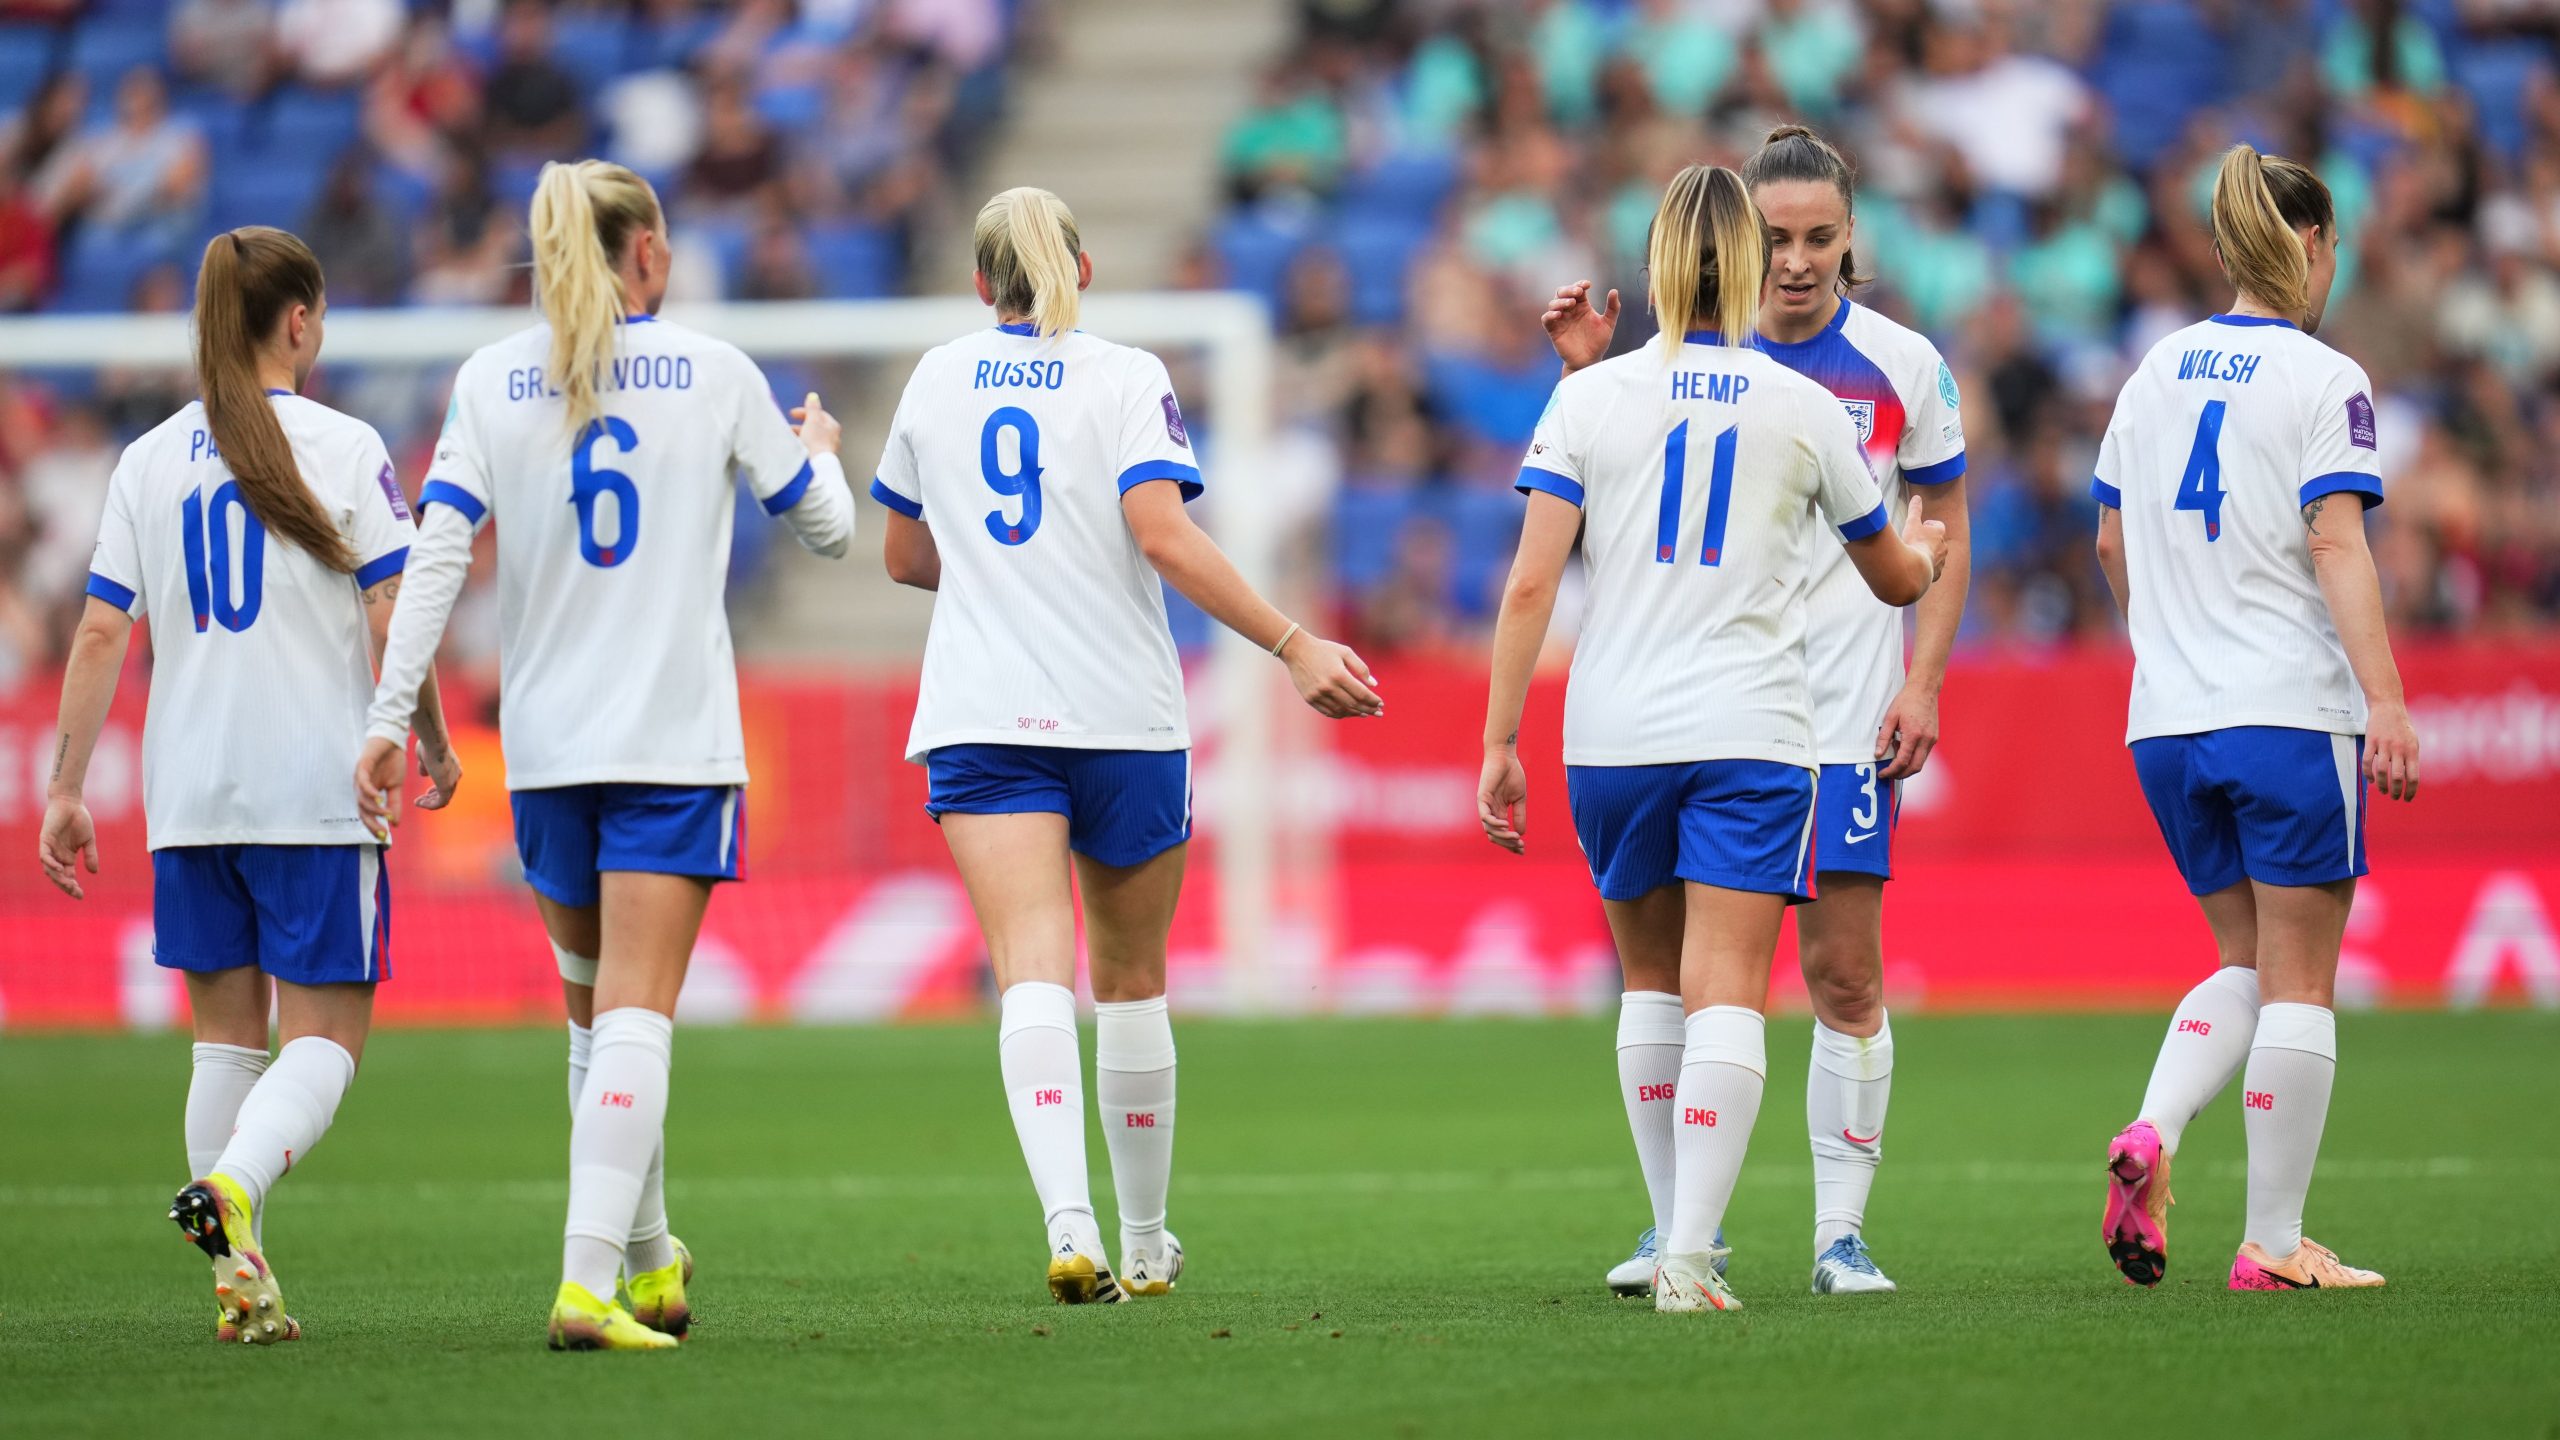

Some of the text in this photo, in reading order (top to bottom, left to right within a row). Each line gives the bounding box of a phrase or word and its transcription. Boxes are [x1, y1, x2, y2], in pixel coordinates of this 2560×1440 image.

[509, 355, 692, 401] GRWOOD
[973, 359, 1064, 390] RUSSO
[2177, 349, 2262, 384] WALSH
[1671, 370, 1750, 405] HEMP
[980, 405, 1046, 546] 9
[2173, 399, 2228, 542] 4
[568, 415, 640, 569] 6
[1655, 417, 1739, 567] 11
[182, 479, 266, 633] 10
[1039, 718, 1059, 730] CAP
[1852, 762, 1878, 830] 3
[2177, 1019, 2212, 1036] ENG
[601, 1091, 634, 1109] ENG
[1035, 1088, 1063, 1107] ENG
[1638, 1083, 1676, 1102] ENG
[2245, 1090, 2274, 1111] ENG
[1125, 1112, 1155, 1129] ENG
[1684, 1107, 1718, 1128] ENG
